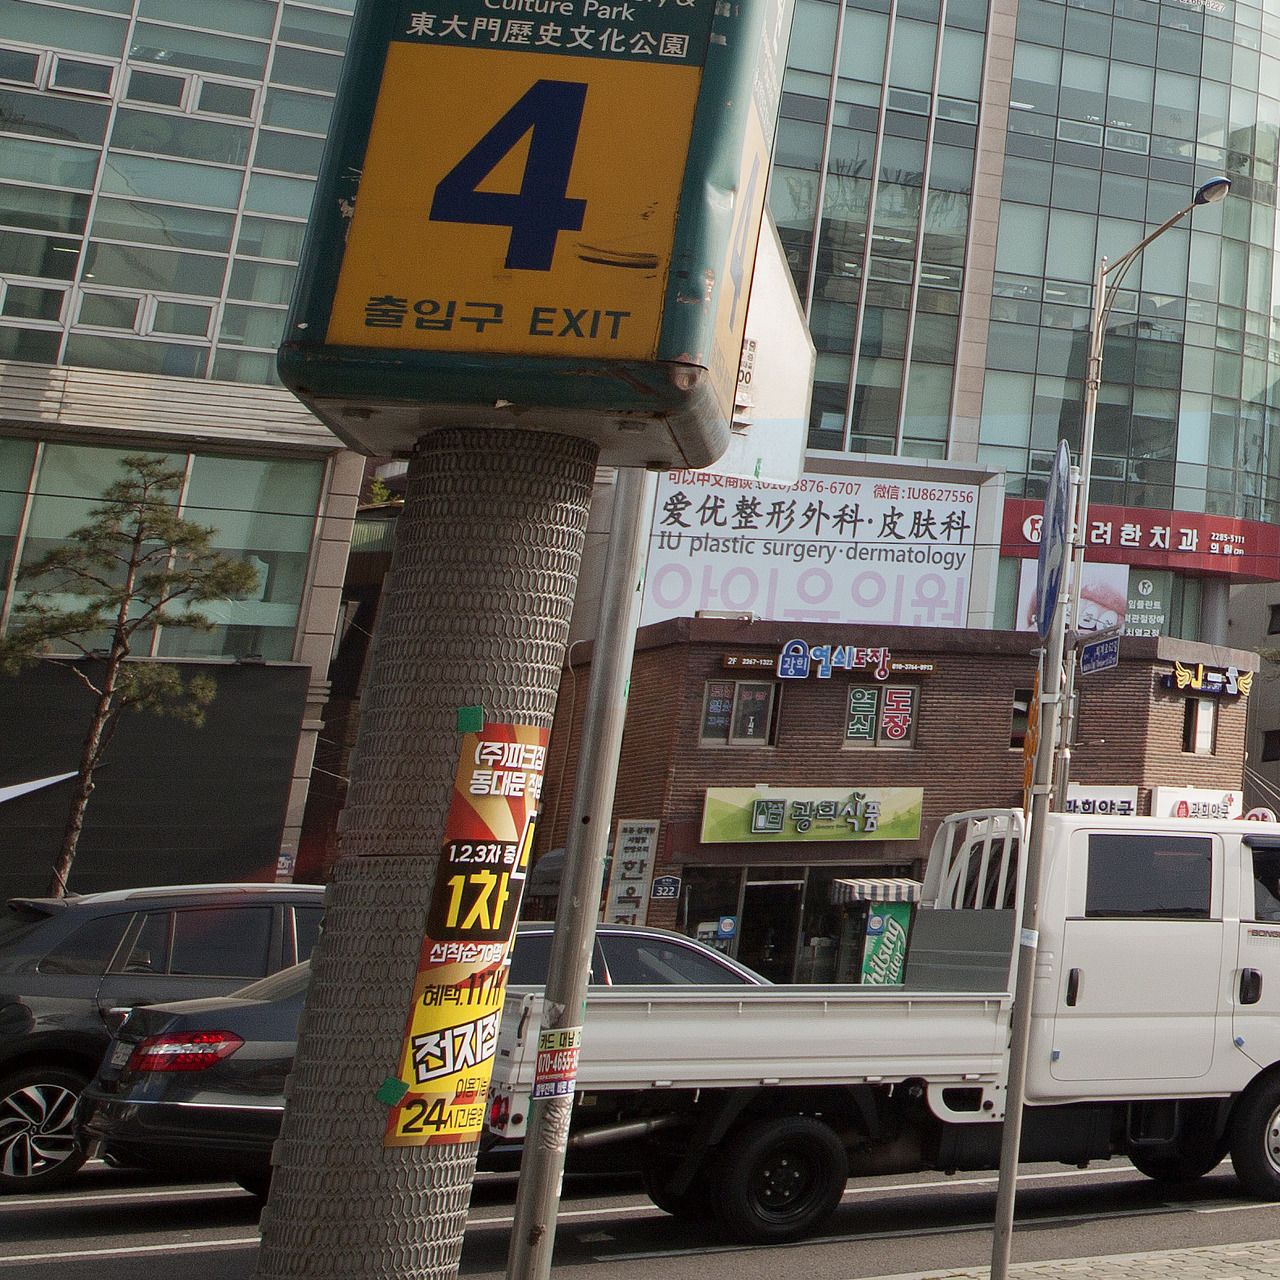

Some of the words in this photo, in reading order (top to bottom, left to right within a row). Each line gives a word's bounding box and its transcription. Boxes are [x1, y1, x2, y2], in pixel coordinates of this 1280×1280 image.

[429, 78, 589, 272] 4
[364, 295, 504, 334] 출입구
[528, 306, 631, 340] EXIT
[657, 531, 683, 552] IU
[689, 533, 756, 557] plastic
[1072, 521, 1200, 553] 려한치과
[847, 688, 879, 740] 열쇠
[883, 689, 913, 740] 도장
[469, 770, 526, 797] 동대문
[446, 870, 510, 931] 1차
[656, 887, 675, 897] 322
[540, 1033, 556, 1048] 카드
